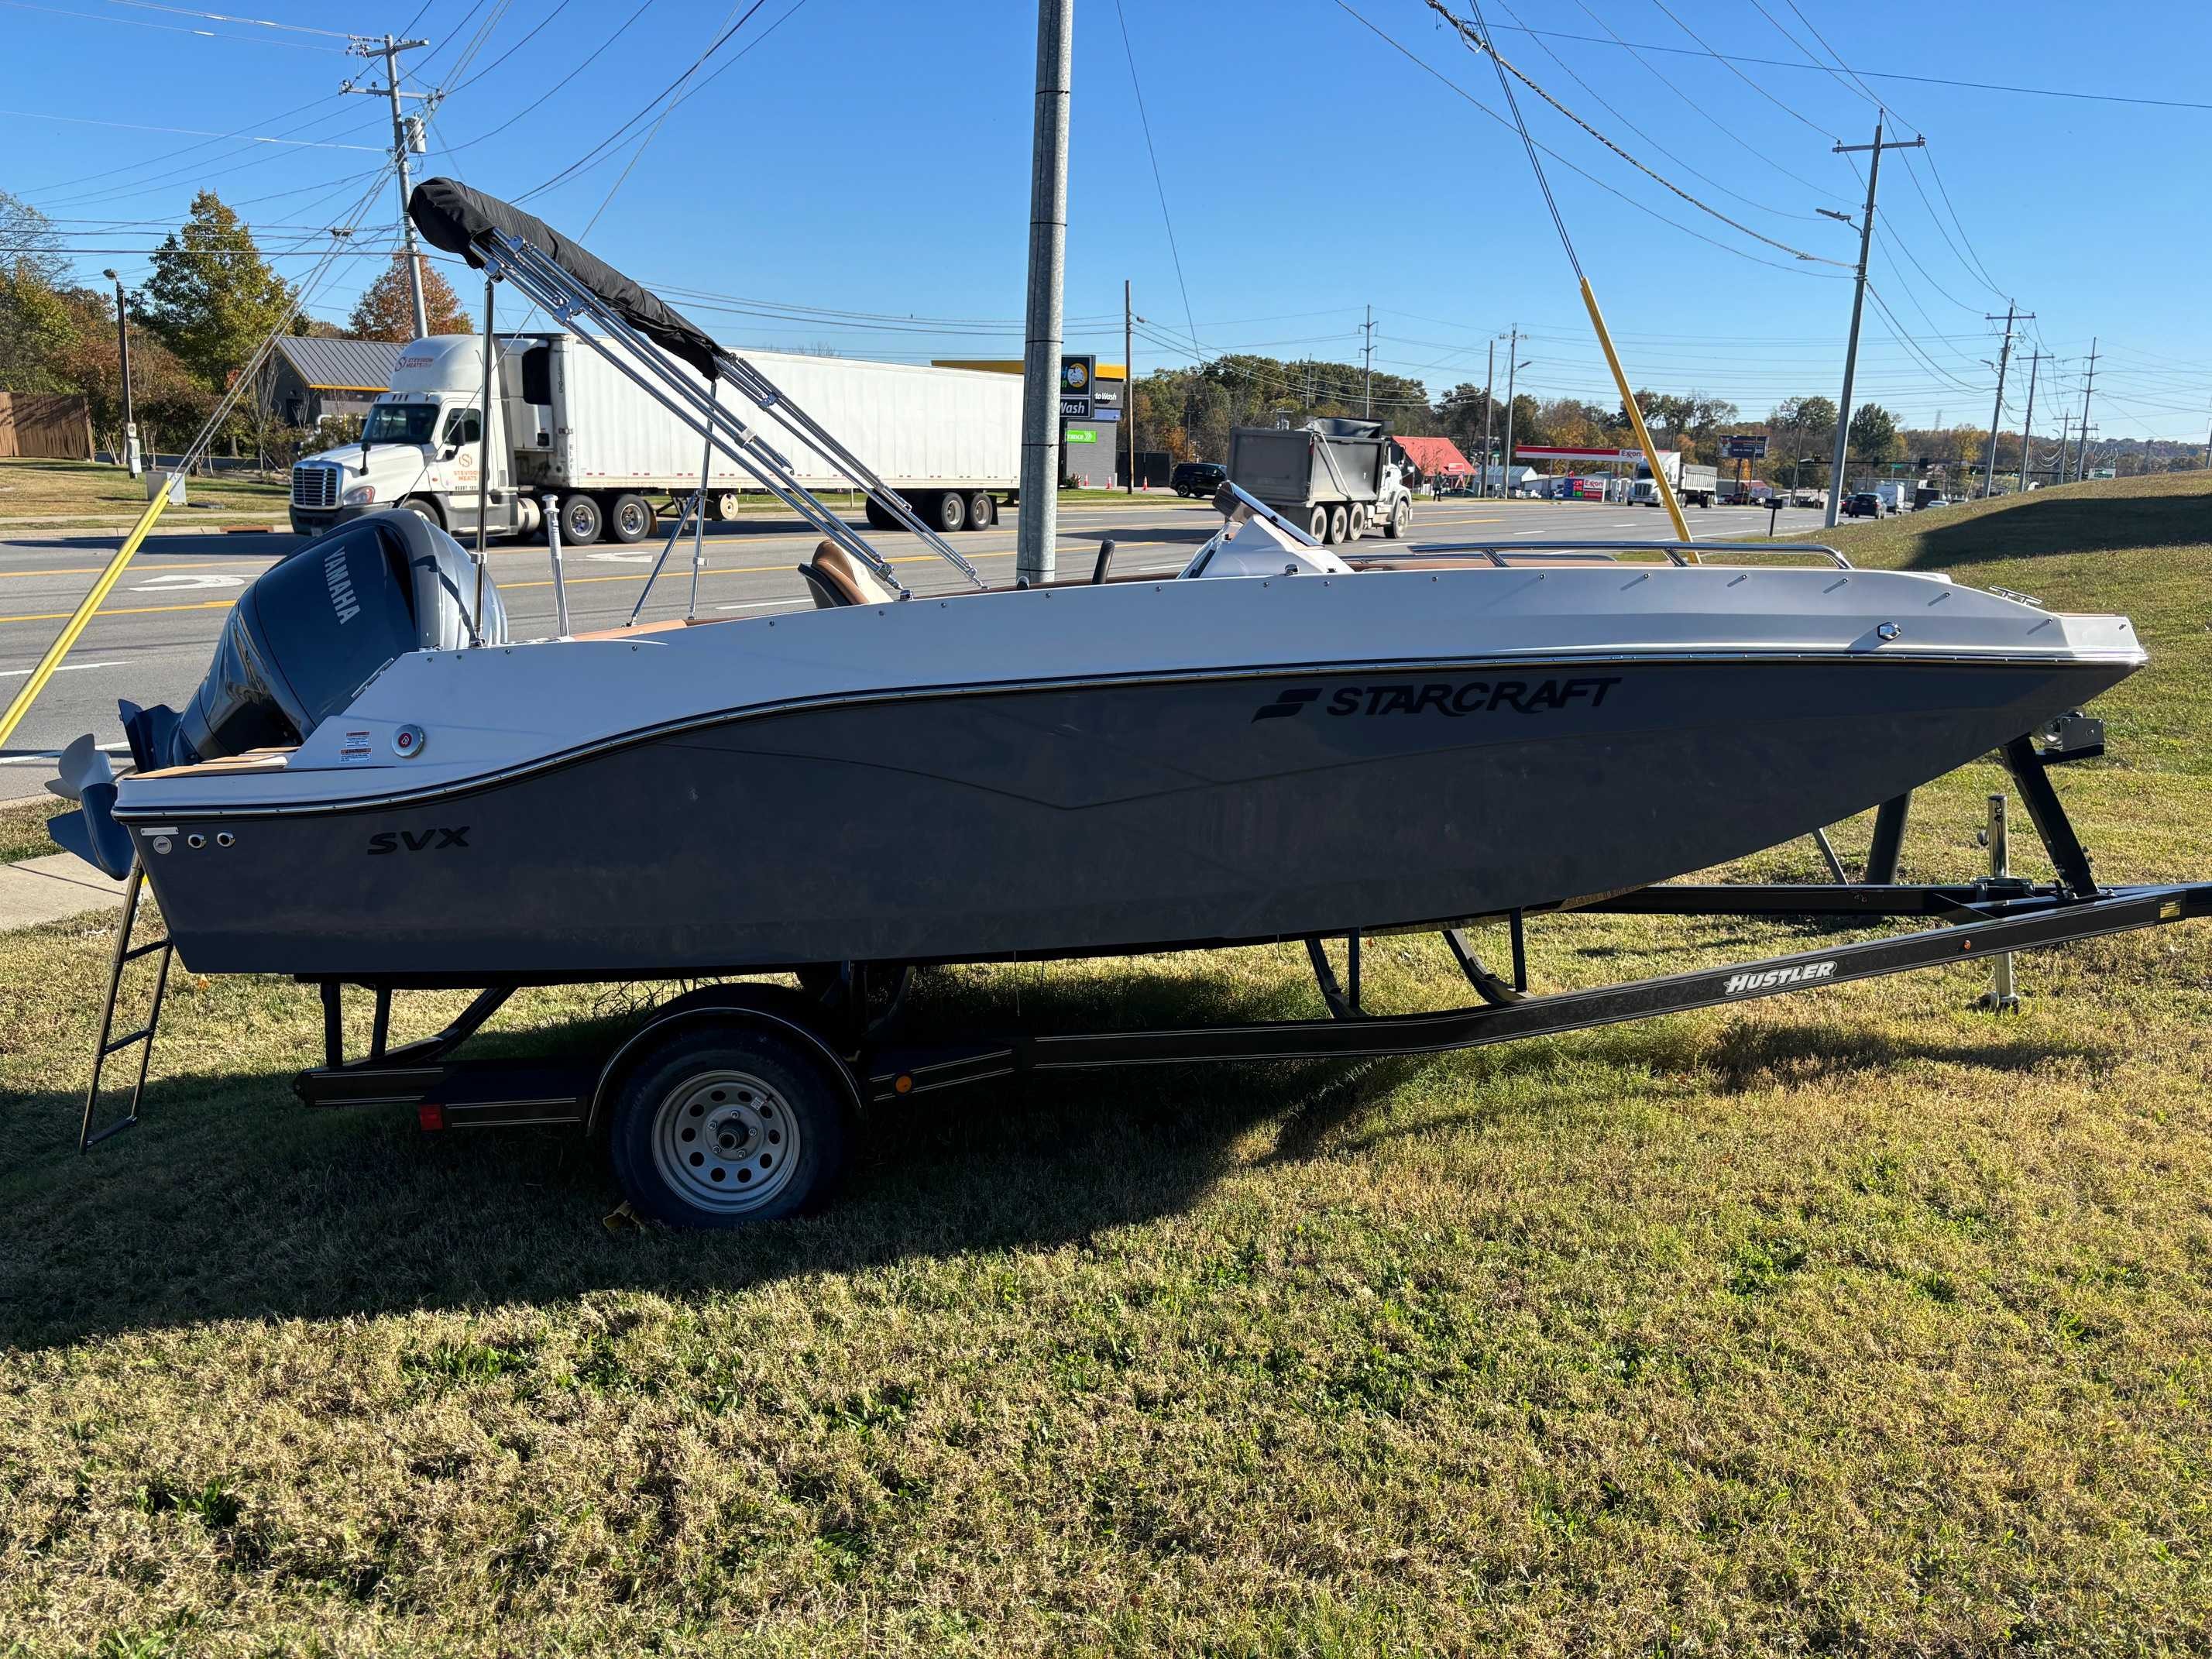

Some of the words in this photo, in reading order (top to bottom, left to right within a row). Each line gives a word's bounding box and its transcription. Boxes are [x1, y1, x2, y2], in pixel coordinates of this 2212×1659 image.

[325, 545, 360, 625] YAMAHA
[1327, 677, 1623, 717] STARCRAFT
[367, 826, 470, 855] SVX
[1725, 962, 1837, 994] HUSTLER
